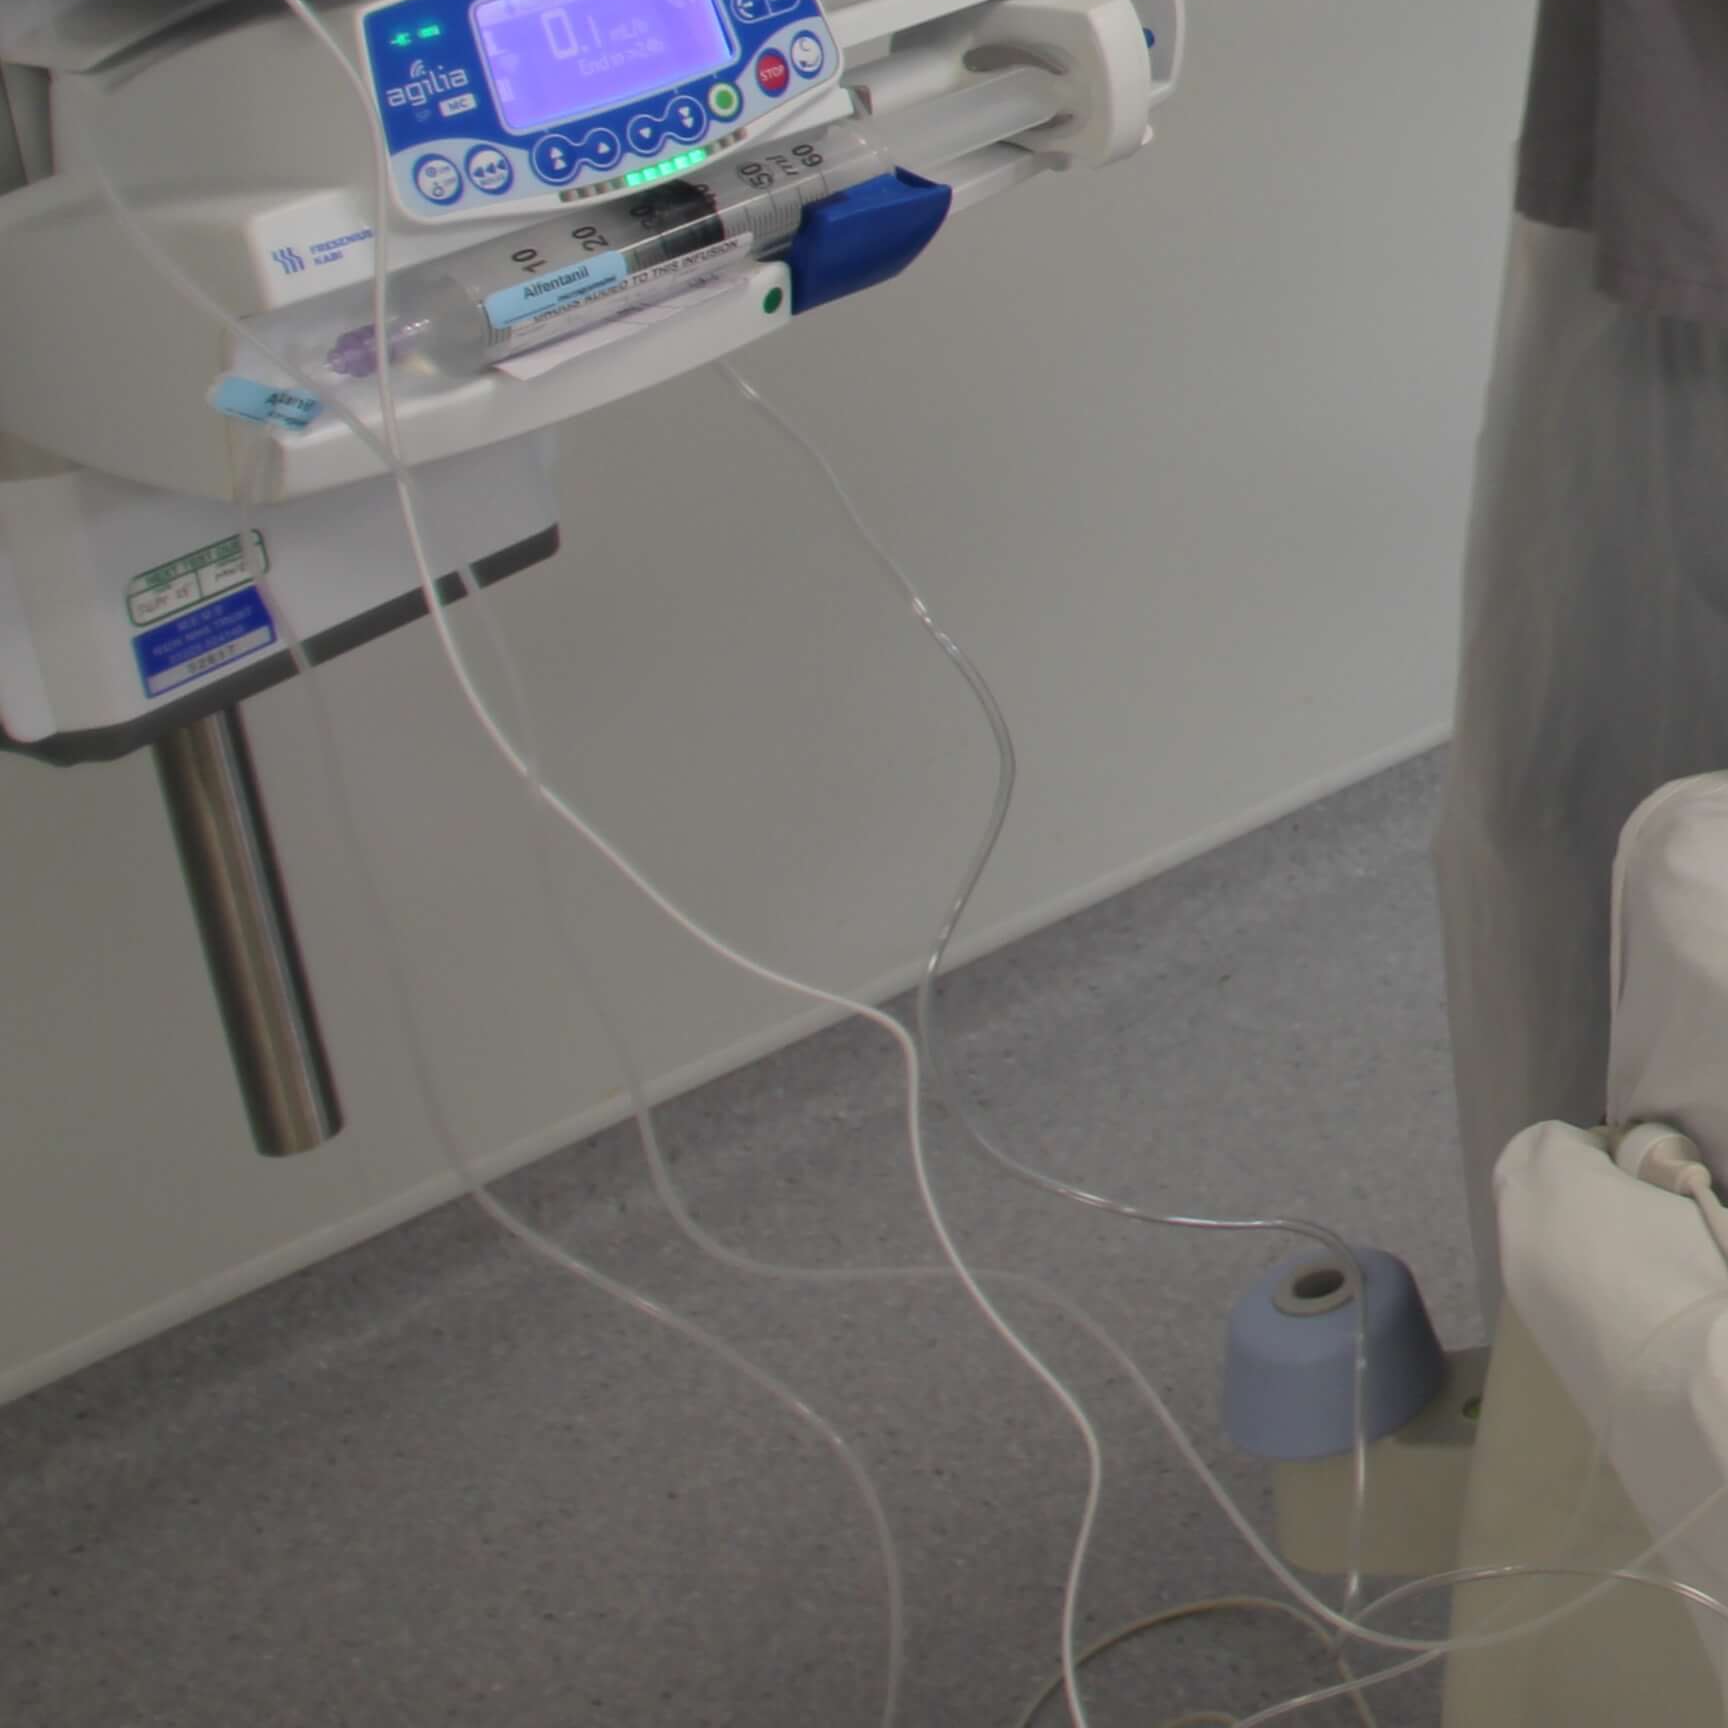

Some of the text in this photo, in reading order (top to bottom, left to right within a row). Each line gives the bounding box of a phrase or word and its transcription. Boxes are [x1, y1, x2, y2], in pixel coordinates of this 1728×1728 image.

[542, 7, 603, 60] 0.1
[385, 64, 469, 107] agilia
[759, 64, 785, 82] STOP
[791, 143, 824, 169] 60
[738, 160, 776, 191] 50
[309, 228, 376, 255] FRESENIUS
[571, 225, 609, 253] 20
[313, 251, 344, 266] KABI
[510, 247, 548, 275] 10
[632, 272, 650, 286] TO
[652, 262, 681, 280] THIS
[682, 239, 740, 268] INFUSION
[522, 264, 591, 301] Alfentanil
